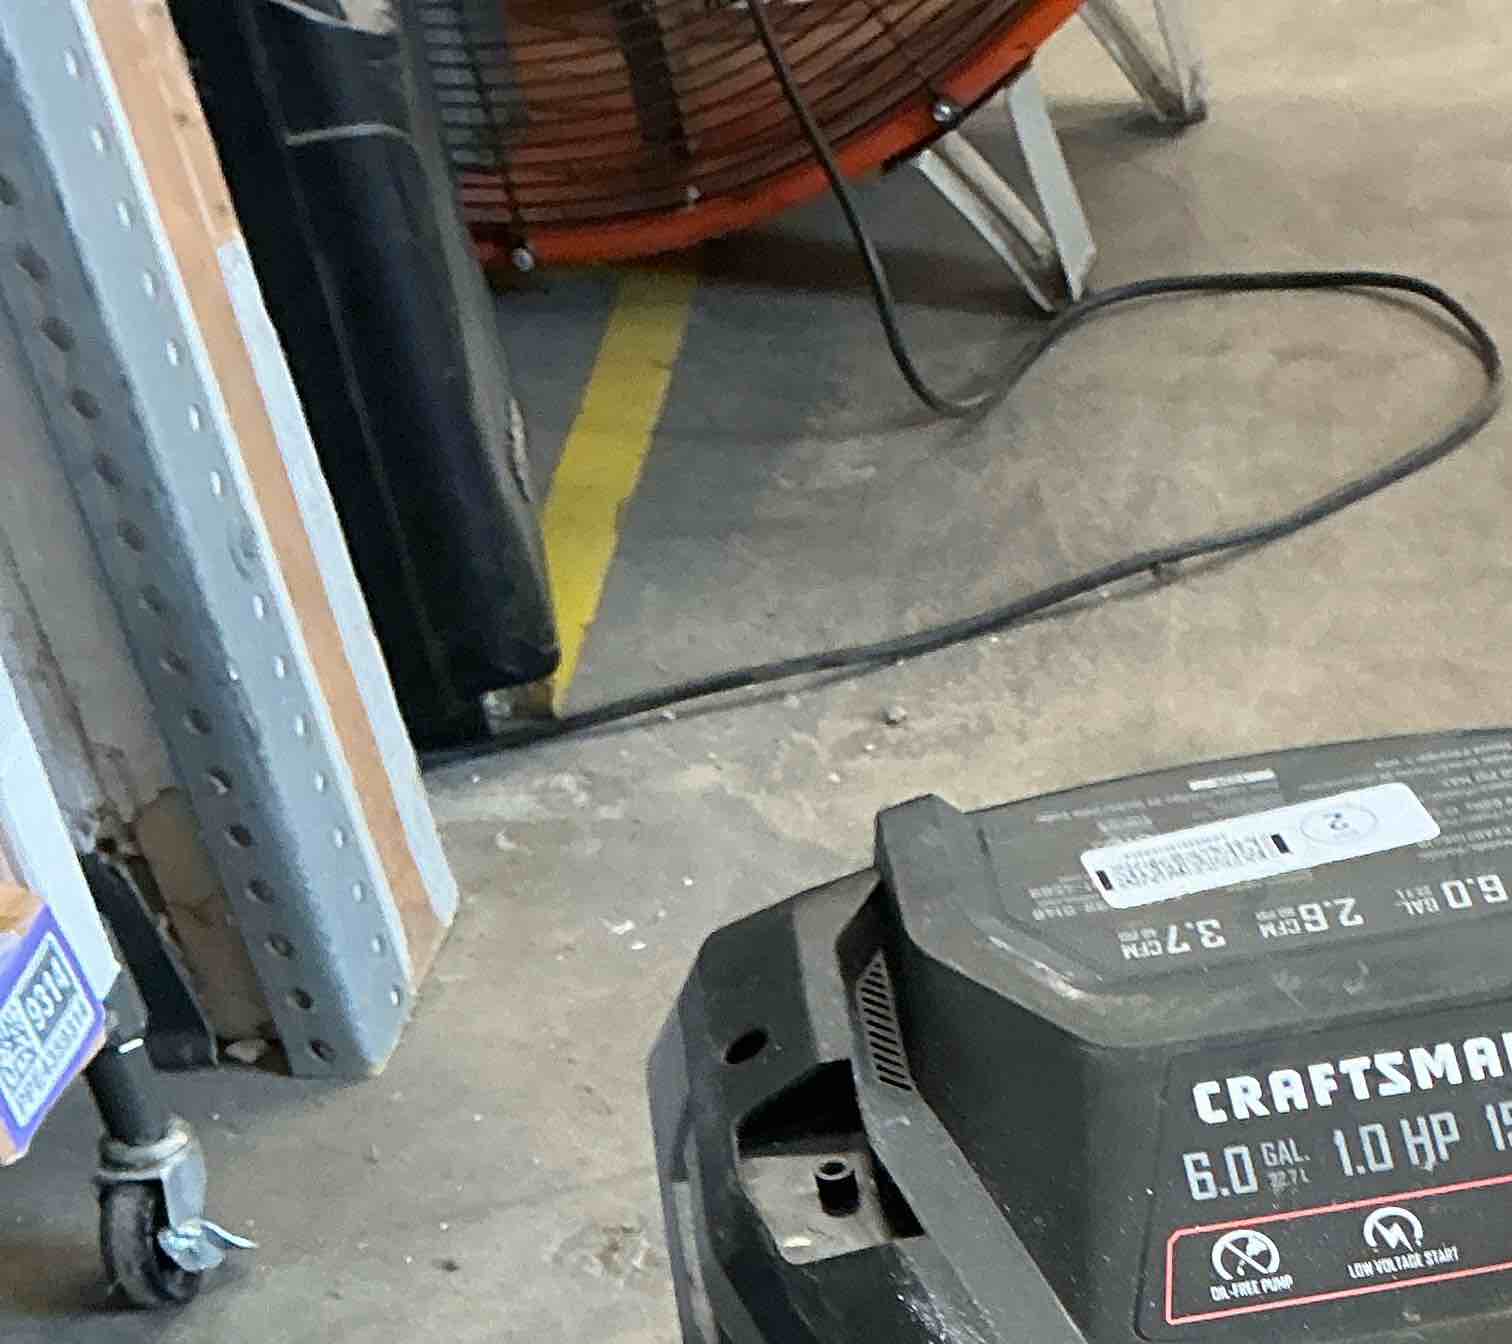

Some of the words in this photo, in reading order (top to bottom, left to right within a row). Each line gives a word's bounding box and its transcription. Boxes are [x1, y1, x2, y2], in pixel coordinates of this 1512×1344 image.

[1440, 873, 1509, 910] 6.0
[1258, 917, 1303, 939] CFM
[1298, 897, 1365, 933] 2.6
[1120, 938, 1164, 960] CFM
[1166, 918, 1227, 955] 3.7
[1182, 1143, 1259, 1202] 6.0
[1260, 1137, 1312, 1168] GAL.
[1332, 1122, 1396, 1178] 1.0
[1400, 1111, 1462, 1168] HP
[1346, 1260, 1375, 1280] LOW
[1373, 1252, 1423, 1277] VOLTAGE
[1423, 1245, 1461, 1268] START
[1209, 1276, 1263, 1301] OIL-FREE
[1262, 1273, 1295, 1296] PUMP
